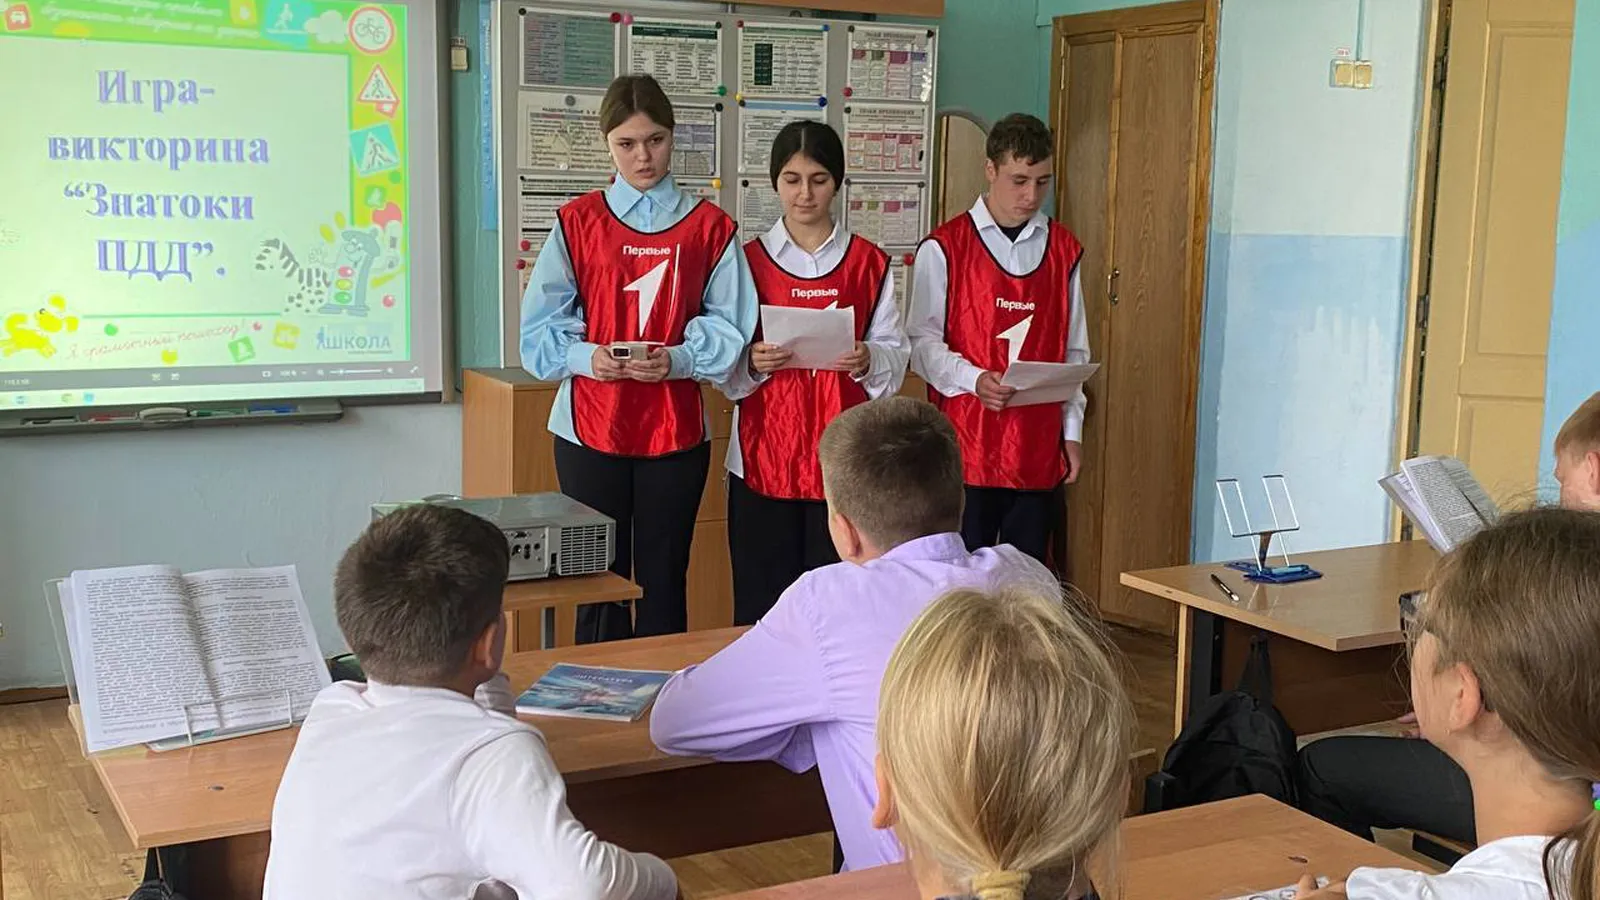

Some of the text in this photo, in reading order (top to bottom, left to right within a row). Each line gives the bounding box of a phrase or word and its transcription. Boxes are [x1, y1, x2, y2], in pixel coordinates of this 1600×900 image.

[96, 69, 215, 113] Игра-
[48, 136, 269, 171] викторина
[622, 245, 671, 258] Первые
[791, 287, 839, 300] Первые
[995, 297, 1036, 312] Первые
[325, 335, 392, 350] ШКОЛА
